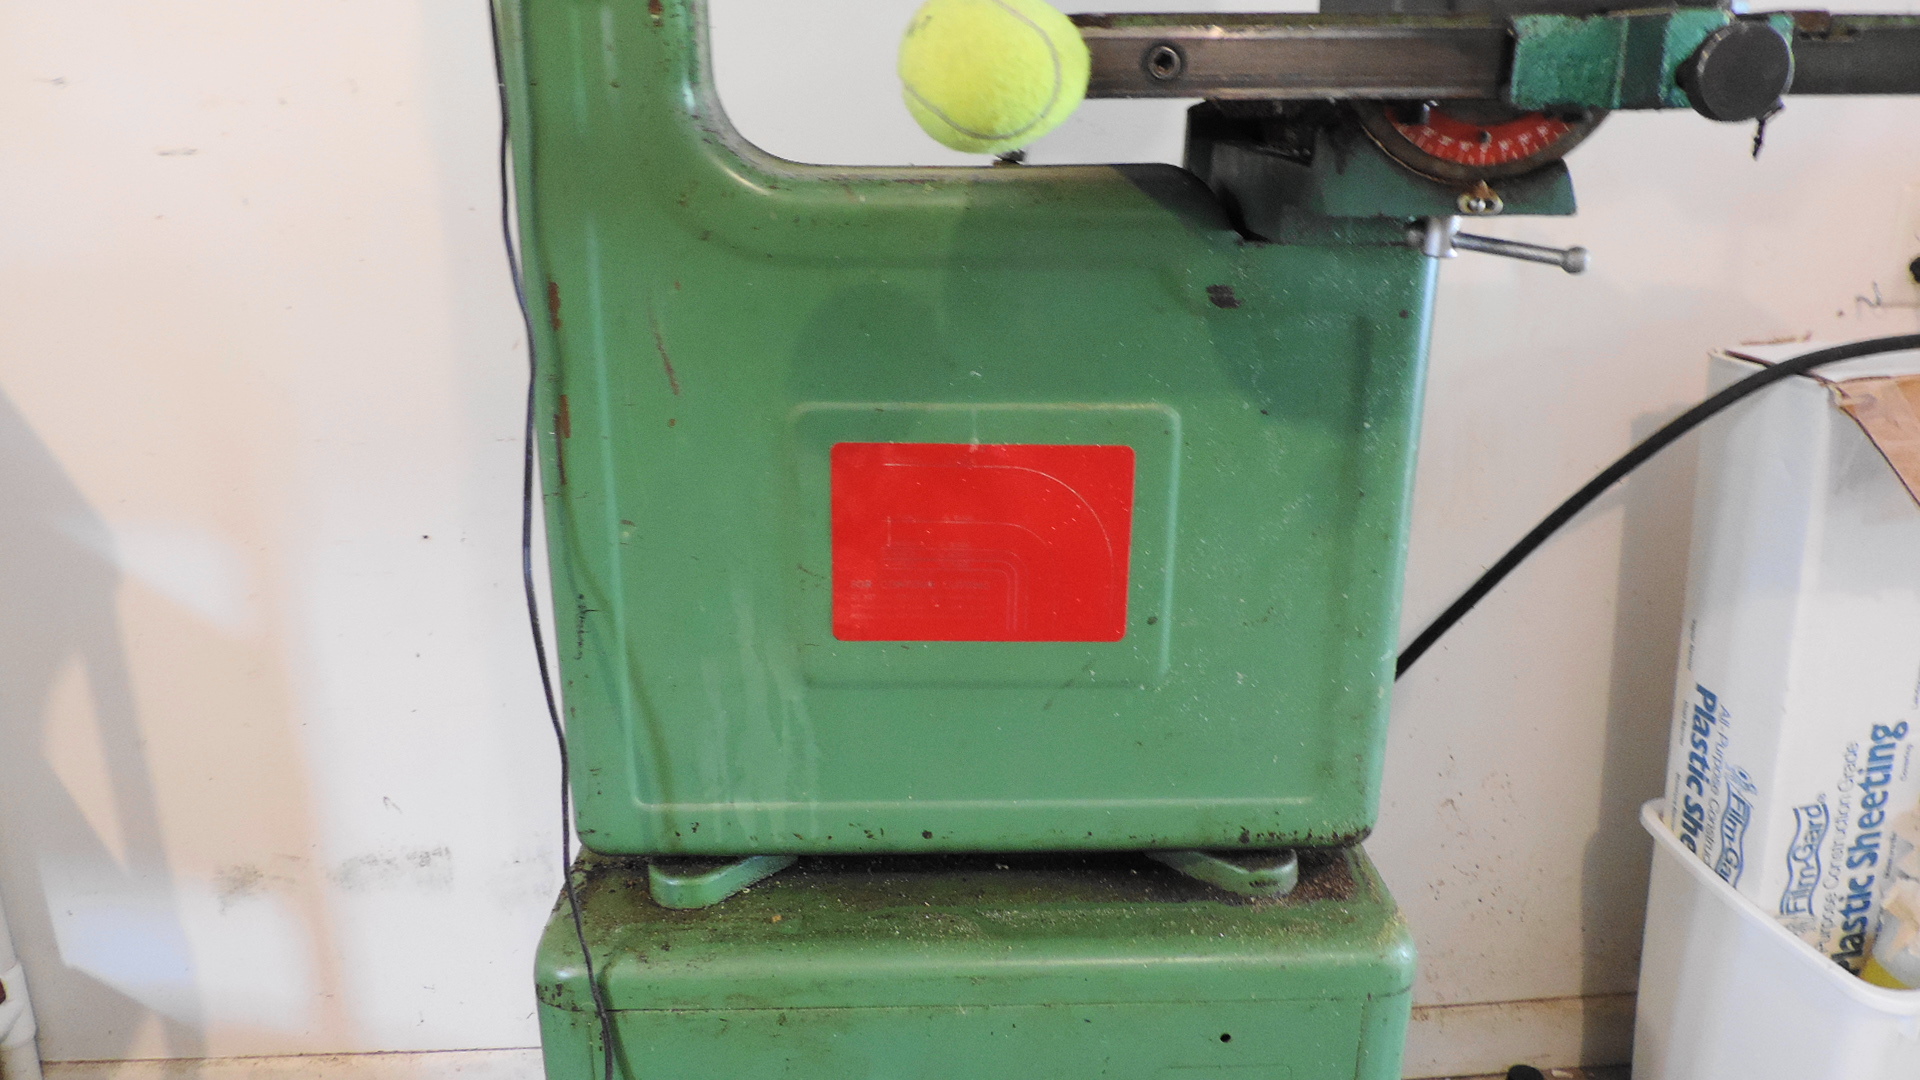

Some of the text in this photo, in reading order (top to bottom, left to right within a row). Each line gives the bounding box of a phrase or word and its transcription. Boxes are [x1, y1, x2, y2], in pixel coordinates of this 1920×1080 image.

[1686, 682, 1718, 796] Plastic
[1711, 704, 1732, 796] All-Purpose
[1846, 720, 1908, 869] Sheeting
[1785, 804, 1823, 914] Film-Gard
